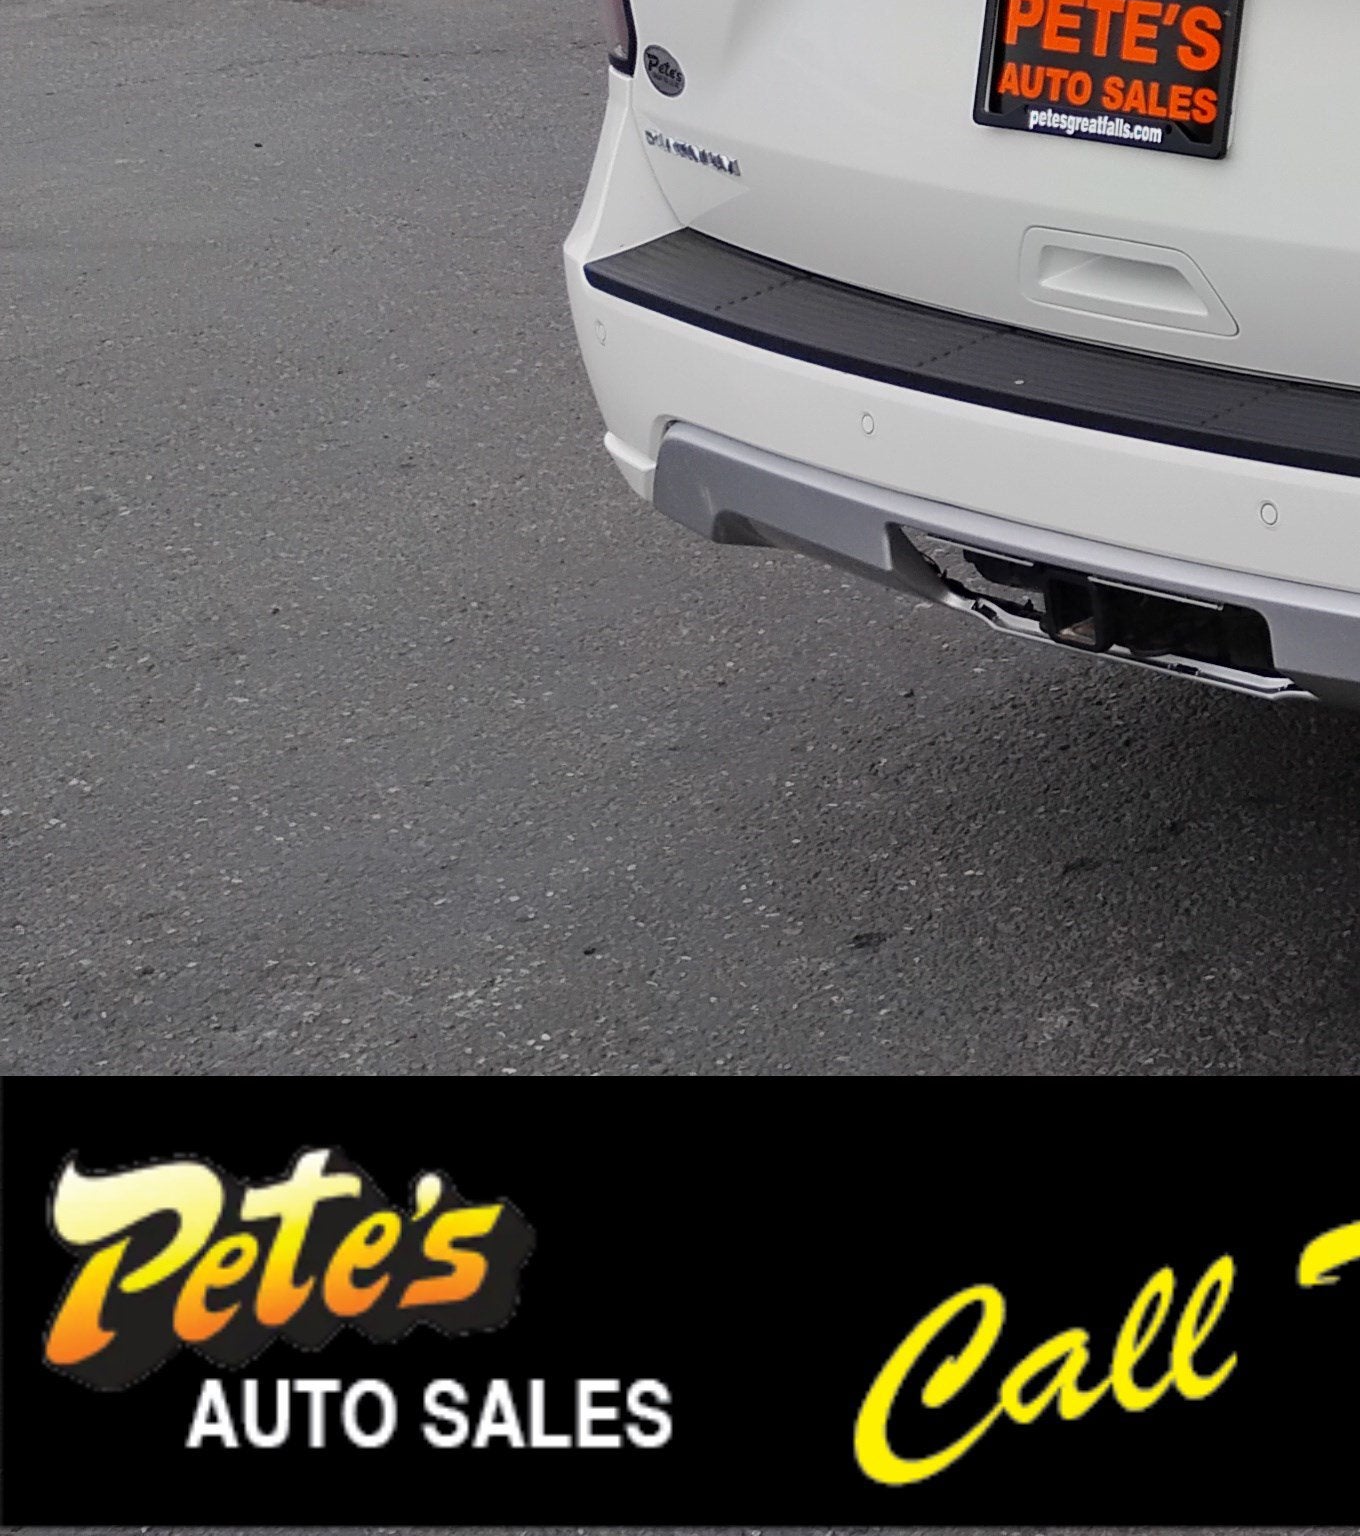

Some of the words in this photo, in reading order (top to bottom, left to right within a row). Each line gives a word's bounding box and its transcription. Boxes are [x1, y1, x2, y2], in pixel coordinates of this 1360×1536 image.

[646, 53, 682, 82] Pete's
[997, 62, 1092, 106] AUTO
[1102, 74, 1218, 124] SALES
[1028, 108, 1162, 143] petesgreatfalls.com
